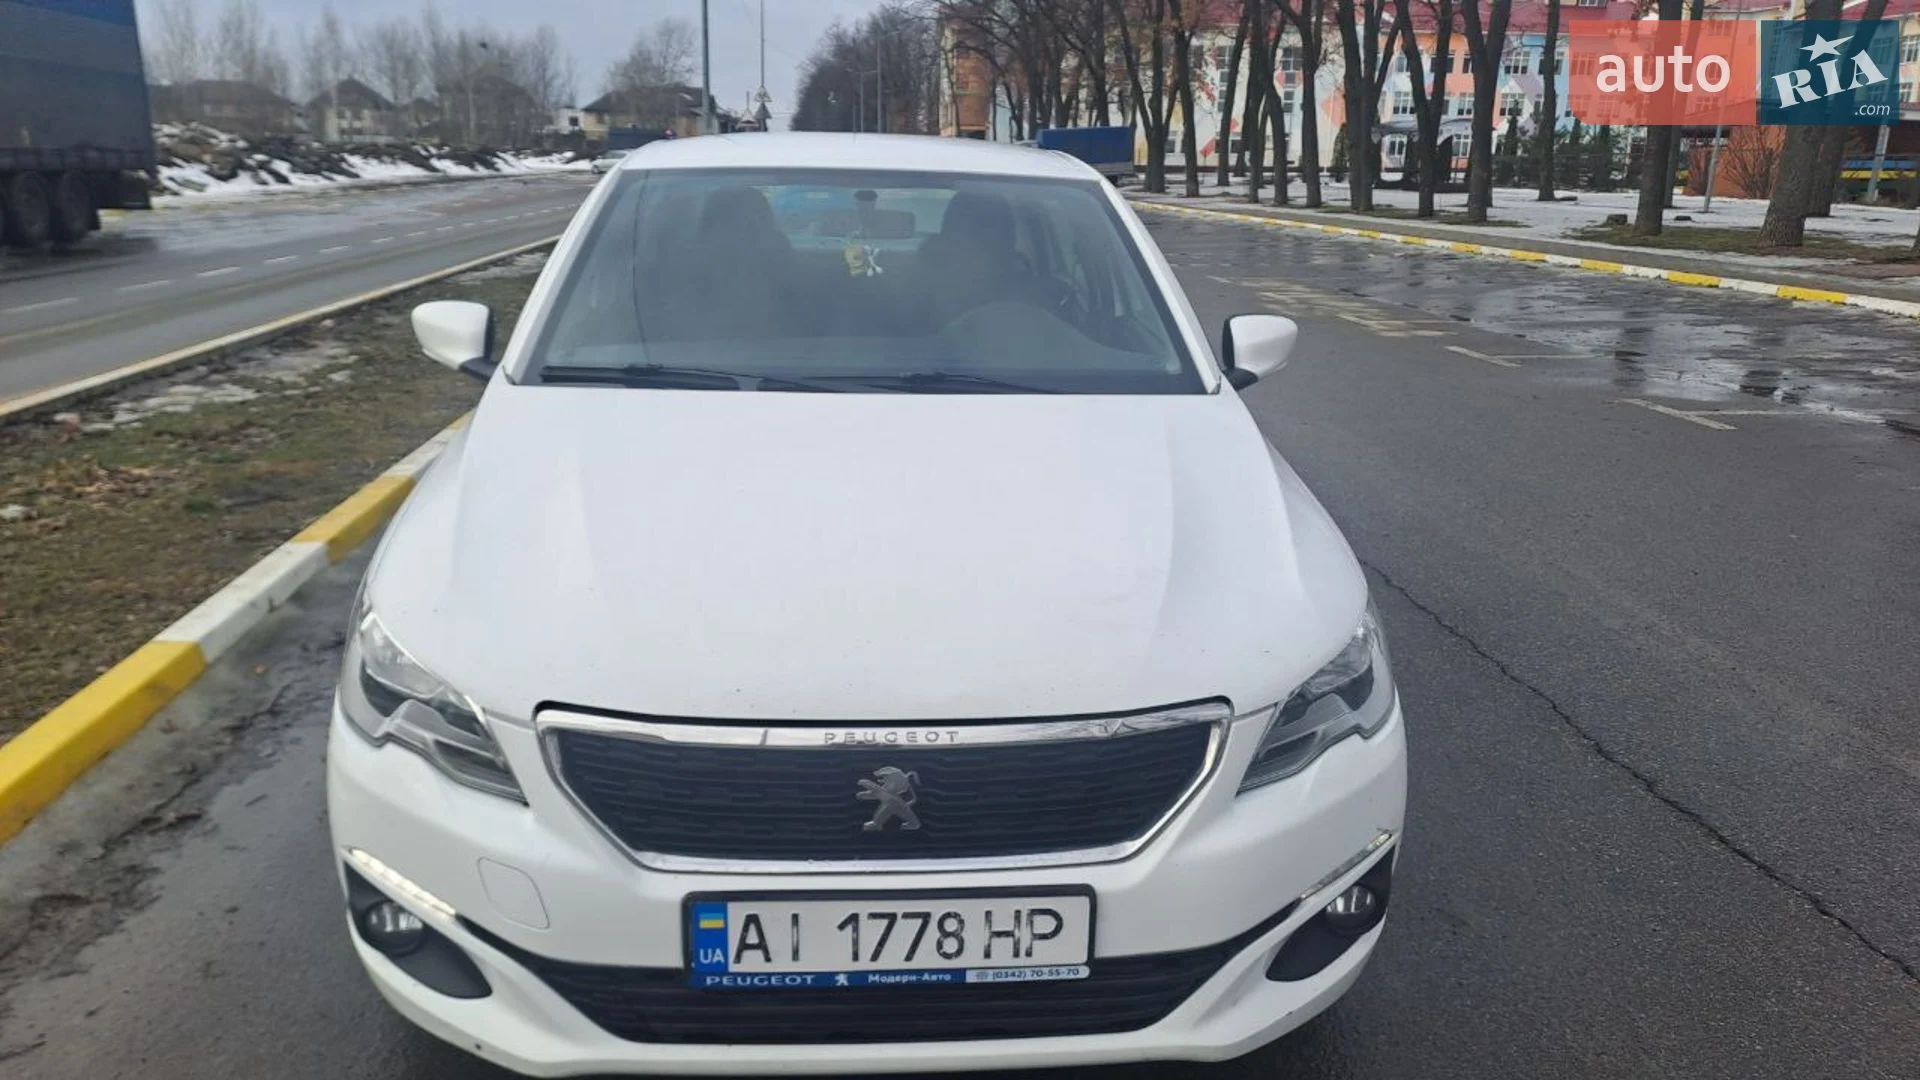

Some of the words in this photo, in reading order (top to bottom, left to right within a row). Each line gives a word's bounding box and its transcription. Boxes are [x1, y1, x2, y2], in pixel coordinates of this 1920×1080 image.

[824, 731, 960, 744] PEUGEOT
[732, 912, 800, 964] AI
[836, 911, 966, 963] 1778
[983, 907, 1064, 960] HP
[699, 948, 725, 964] UA
[705, 974, 817, 987] PEUGEOT
[867, 971, 952, 984] Модерн-Авто
[992, 969, 1027, 981] (0342)
[1030, 967, 1080, 979] 70-55-70
